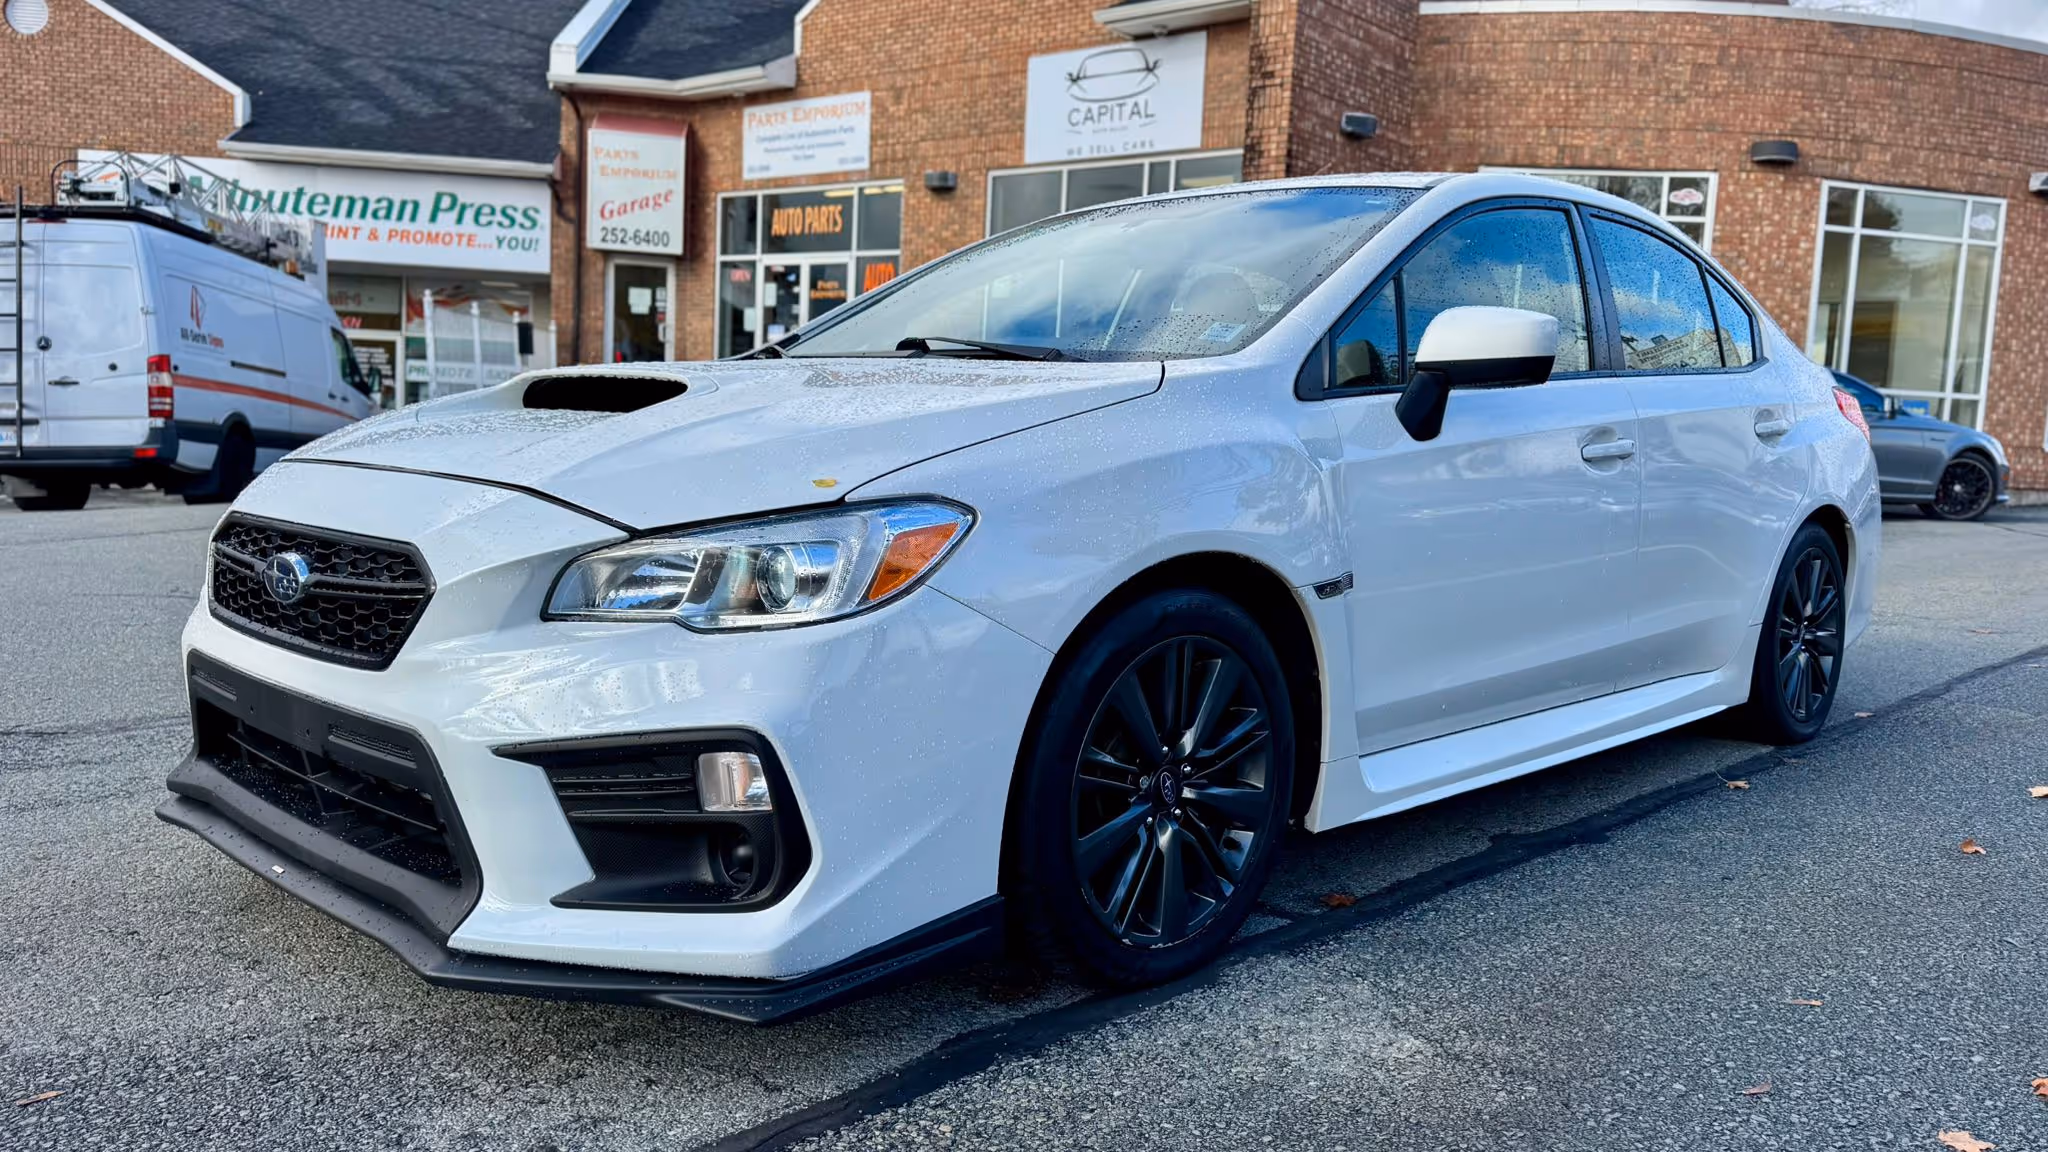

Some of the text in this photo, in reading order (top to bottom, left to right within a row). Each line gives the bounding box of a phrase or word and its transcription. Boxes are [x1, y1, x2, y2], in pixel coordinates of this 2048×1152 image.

[748, 101, 865, 127] PARTS EMPORIUM
[1067, 99, 1156, 127] CAPITAL
[428, 191, 541, 230] Press
[600, 188, 674, 221] Garage
[771, 203, 843, 237] AUTO PARTS
[367, 232, 380, 243] &
[600, 226, 670, 247] 252-6400
